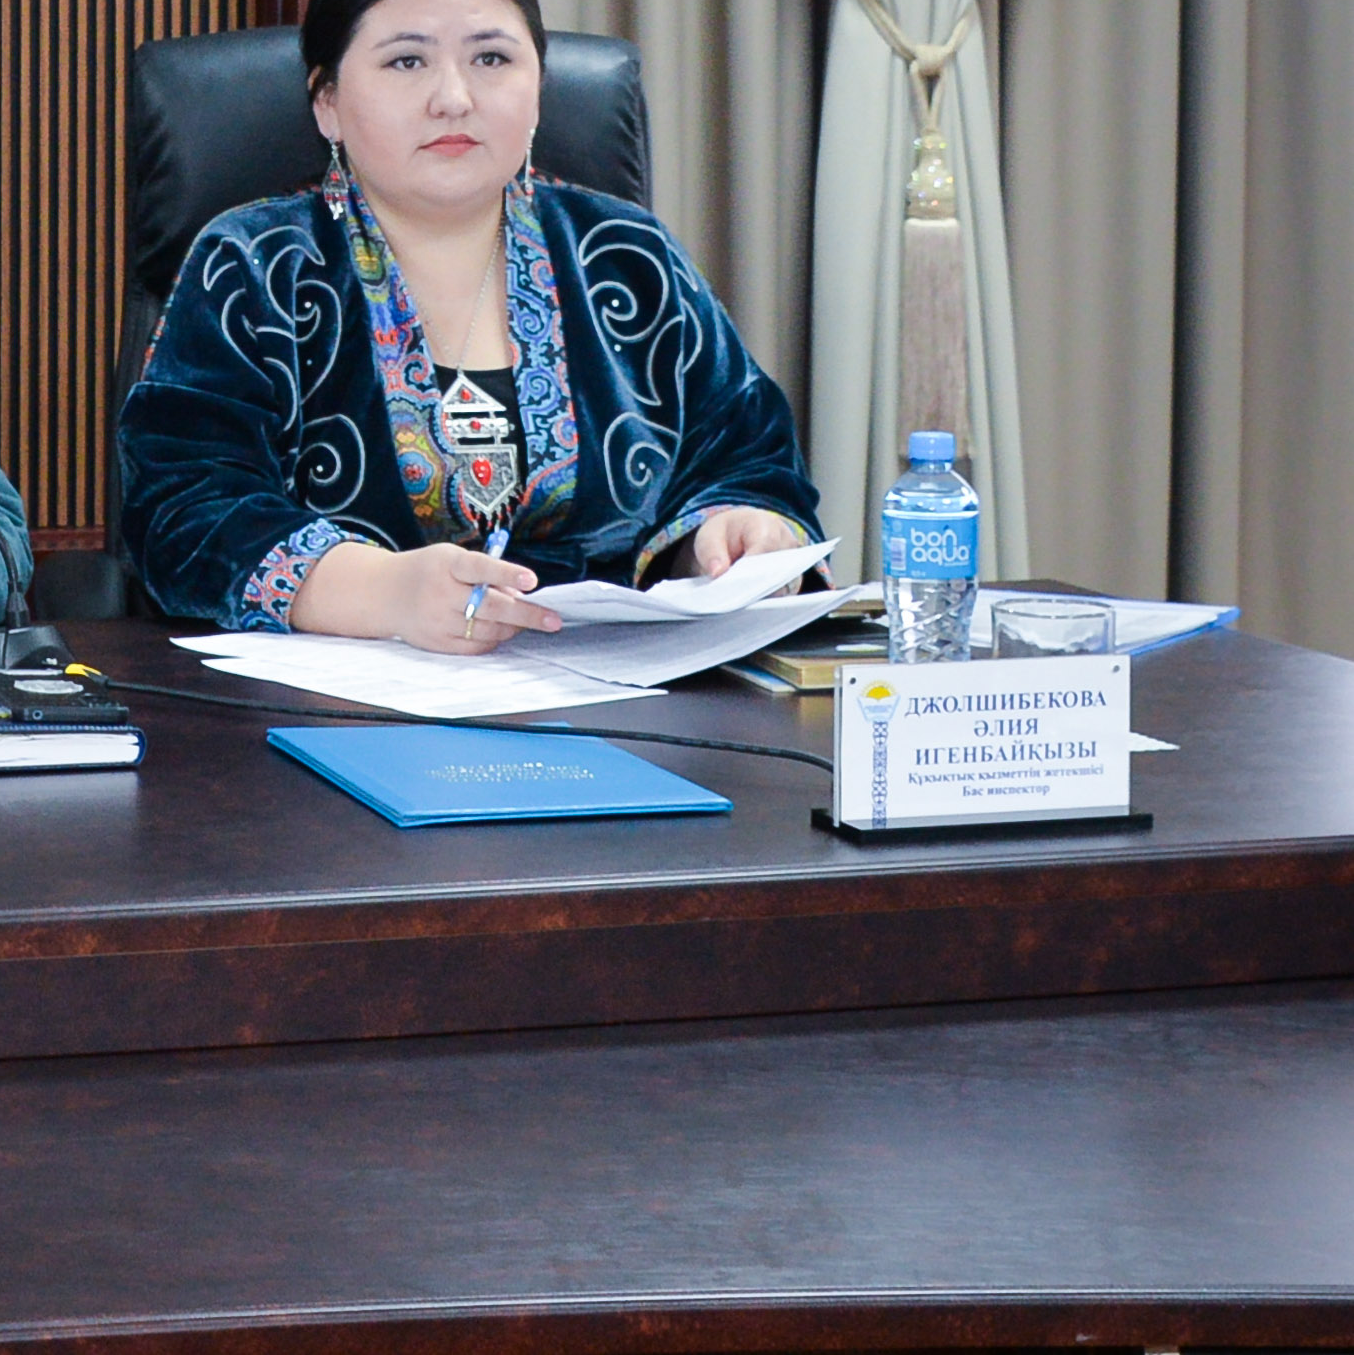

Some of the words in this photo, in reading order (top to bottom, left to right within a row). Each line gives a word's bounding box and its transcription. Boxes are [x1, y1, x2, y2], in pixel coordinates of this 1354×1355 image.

[910, 526, 958, 548] bon
[911, 545, 970, 566] aqua
[903, 689, 1108, 718] ДЖОЛШИБЕКОВА
[973, 717, 1039, 738] ӘЛИЯ
[914, 739, 1098, 766] ИГЕНБАЙҚЫЗЫ
[962, 785, 984, 797] Бас
[987, 783, 1050, 797] инспектор
